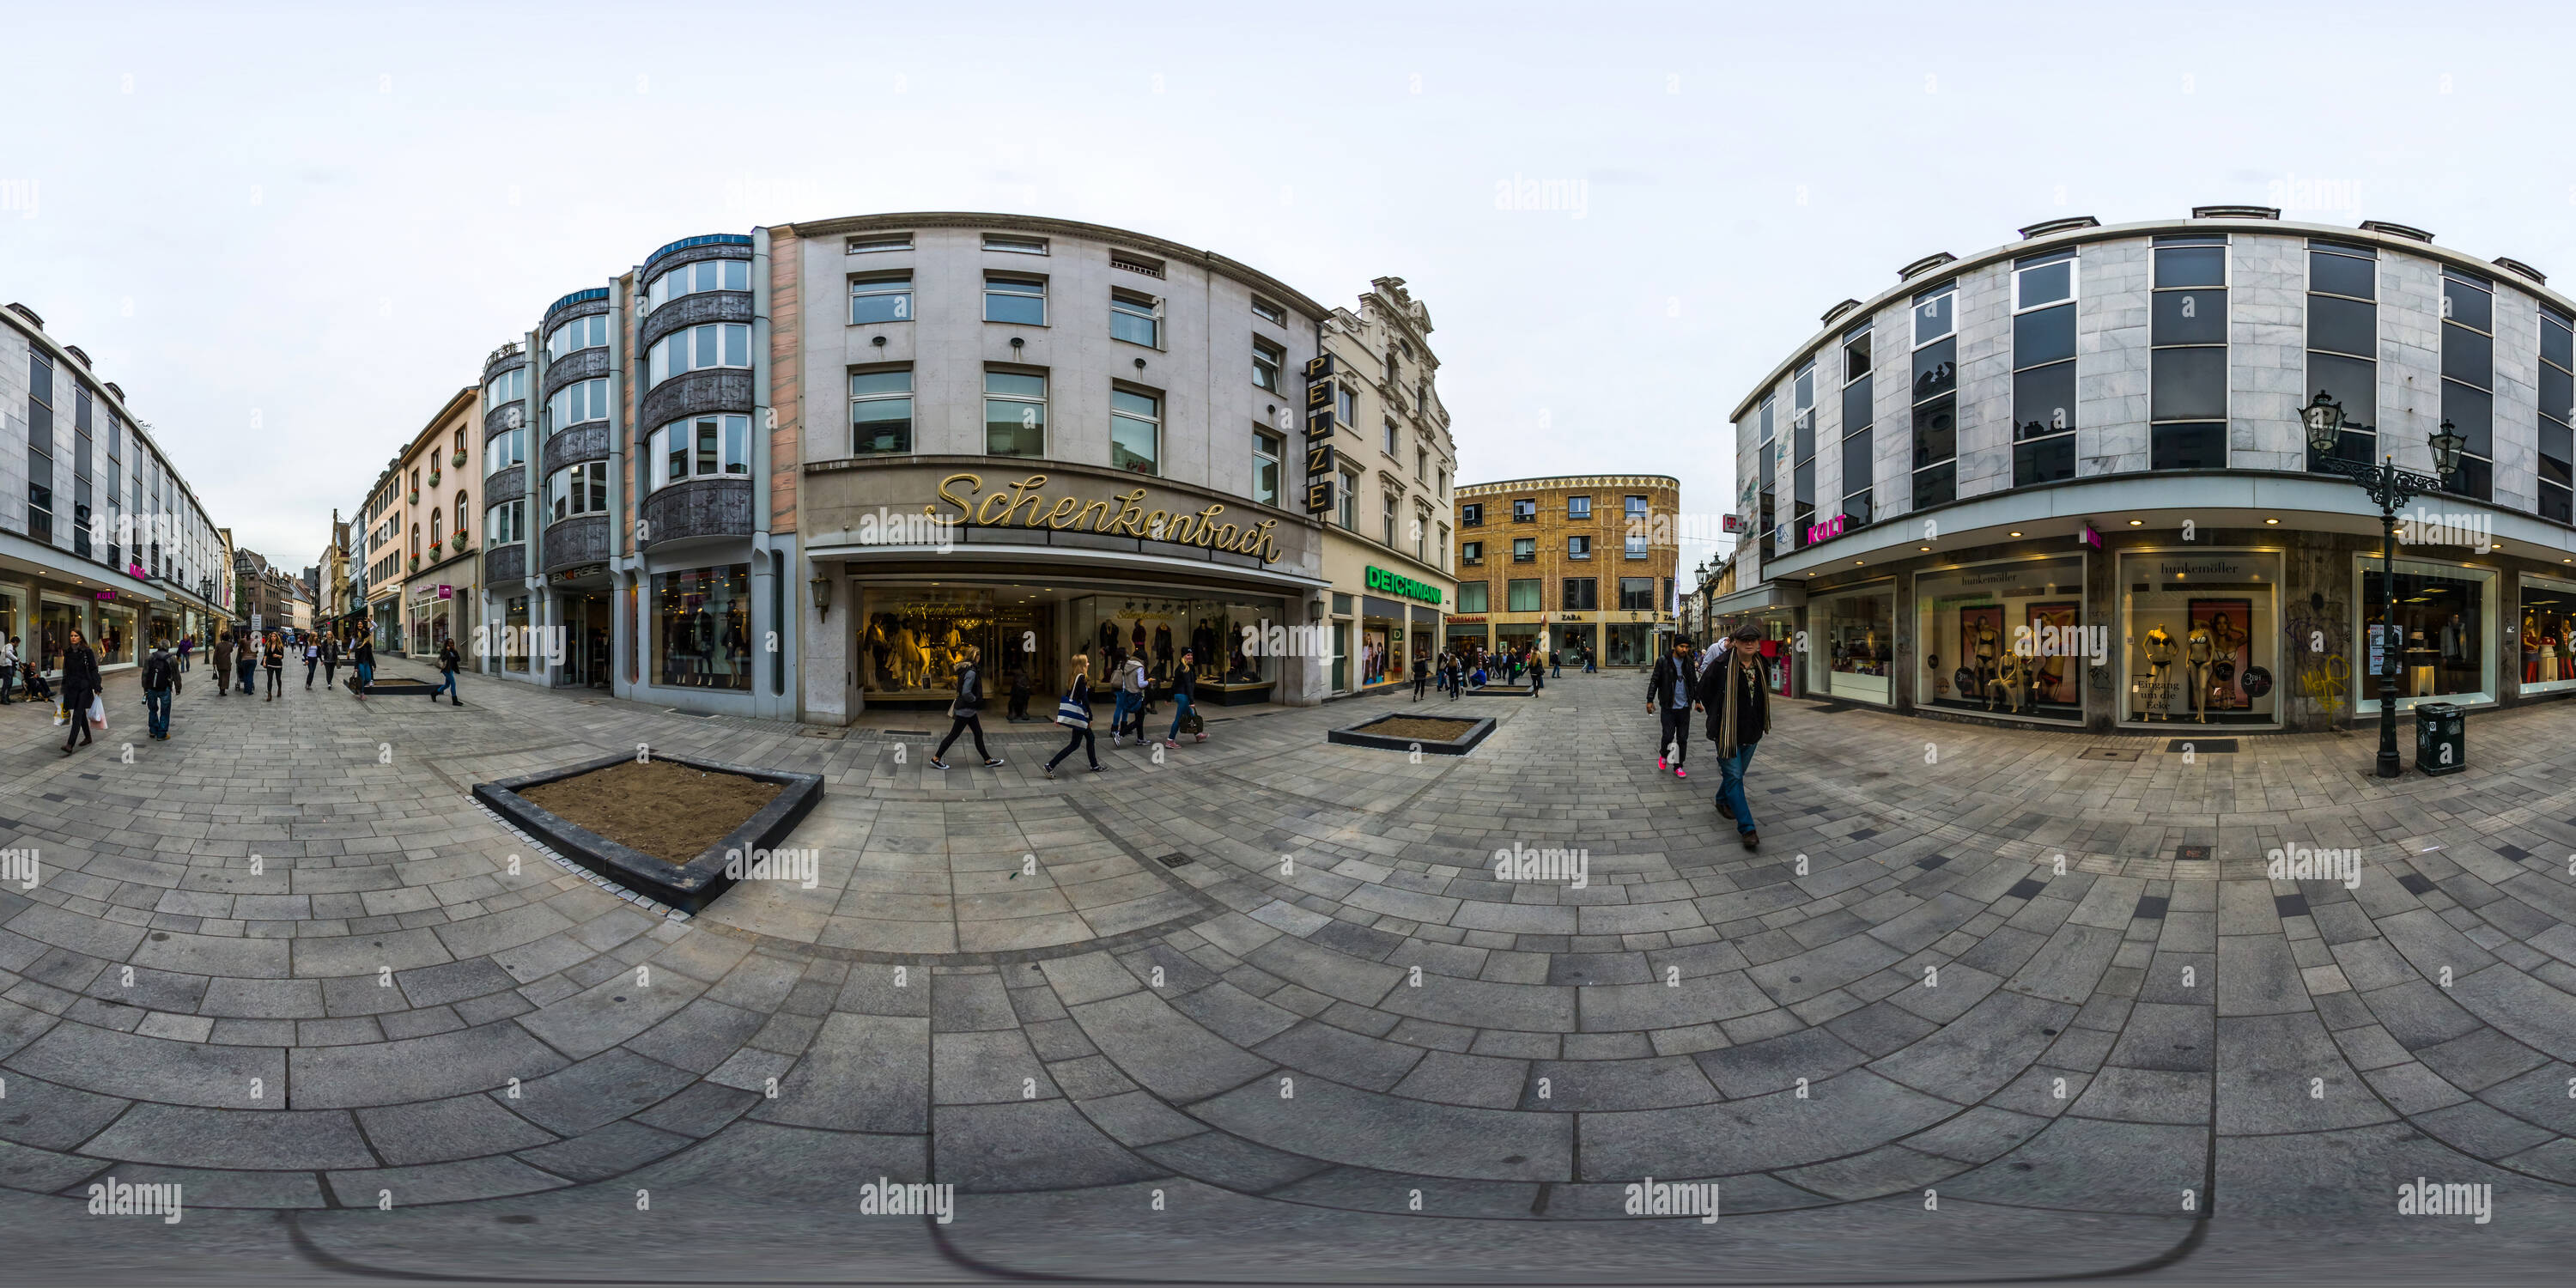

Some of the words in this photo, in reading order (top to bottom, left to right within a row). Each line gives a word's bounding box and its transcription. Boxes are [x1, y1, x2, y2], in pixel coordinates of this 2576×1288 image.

[1308, 356, 1328, 509] PELZE
[1807, 514, 1846, 544] KULT
[1961, 572, 2017, 586] hunkemöller
[2160, 562, 2239, 574] hunkemöller
[1366, 565, 1442, 605] DEICHMANN
[2137, 680, 2179, 690] Eingang
